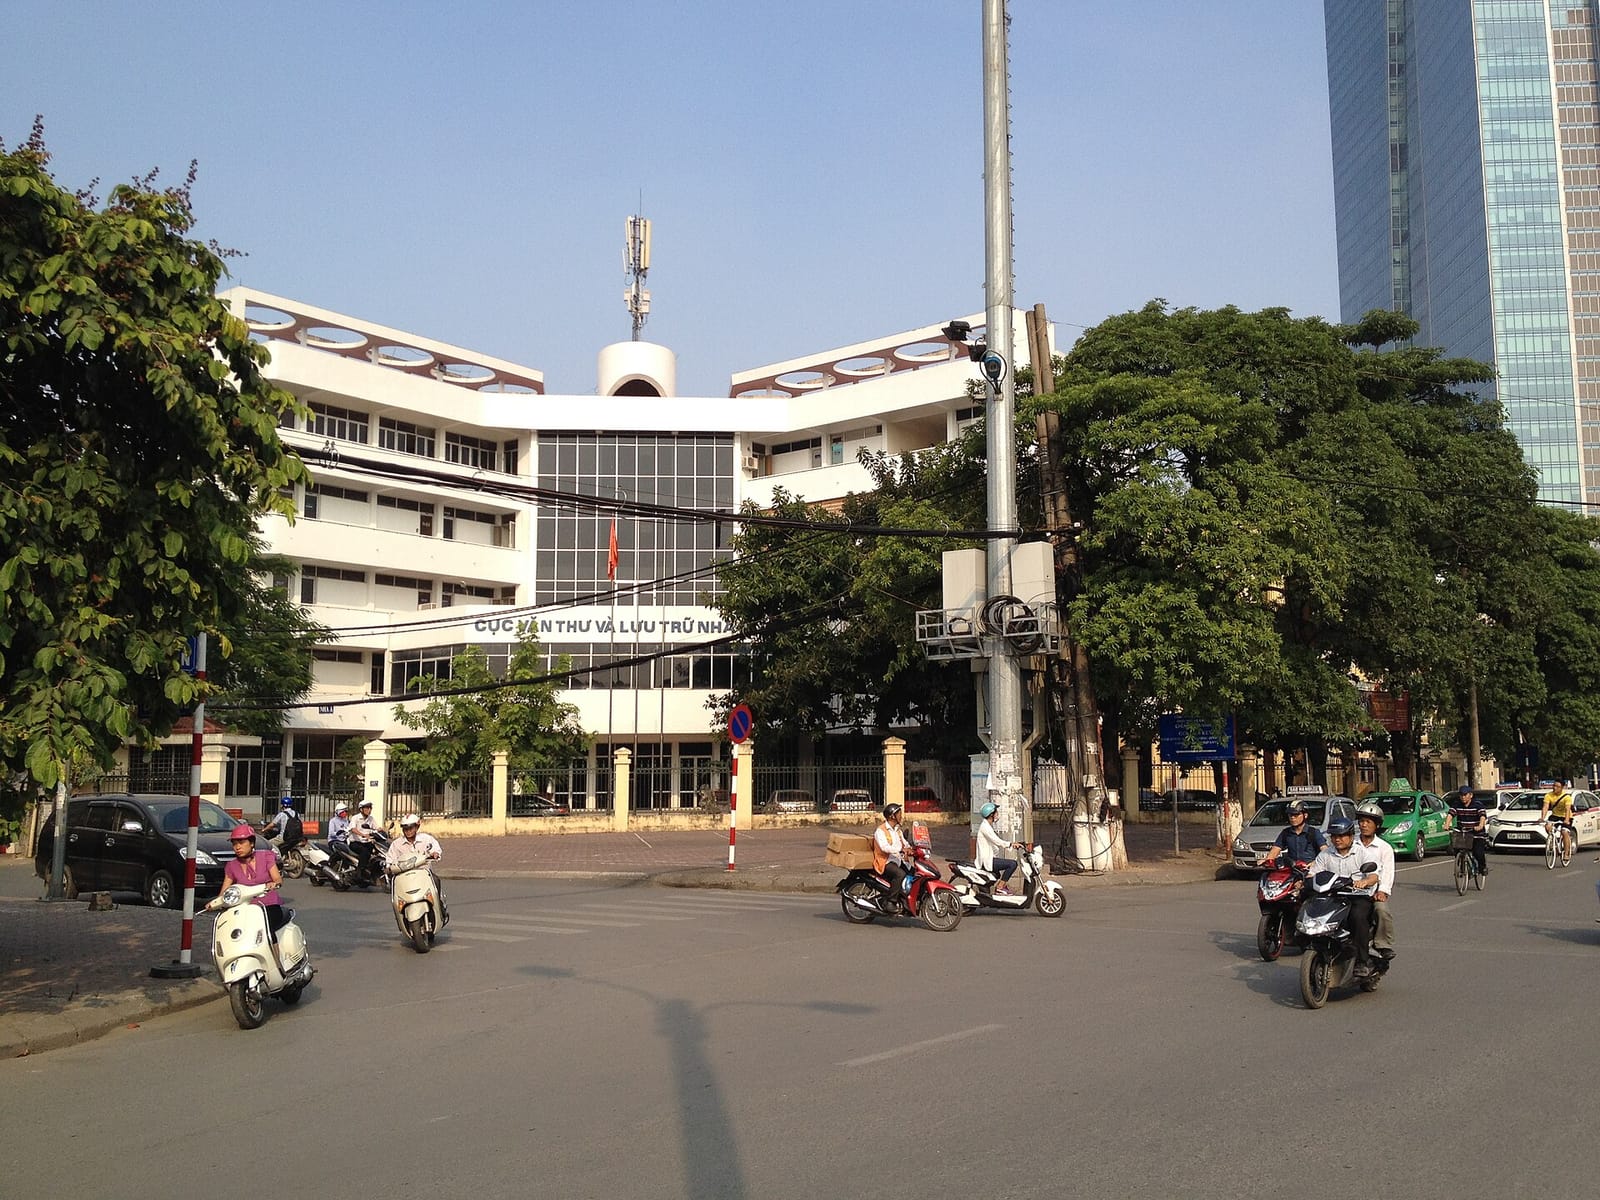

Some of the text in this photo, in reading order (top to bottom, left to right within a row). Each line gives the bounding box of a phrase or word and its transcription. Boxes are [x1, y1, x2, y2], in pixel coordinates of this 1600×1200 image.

[474, 619, 514, 636] CỤC
[518, 616, 552, 633] VĂN
[555, 618, 592, 633] THƯ
[595, 616, 616, 633] VÀ
[619, 619, 656, 633] LƯU
[658, 616, 695, 633] TRỮ
